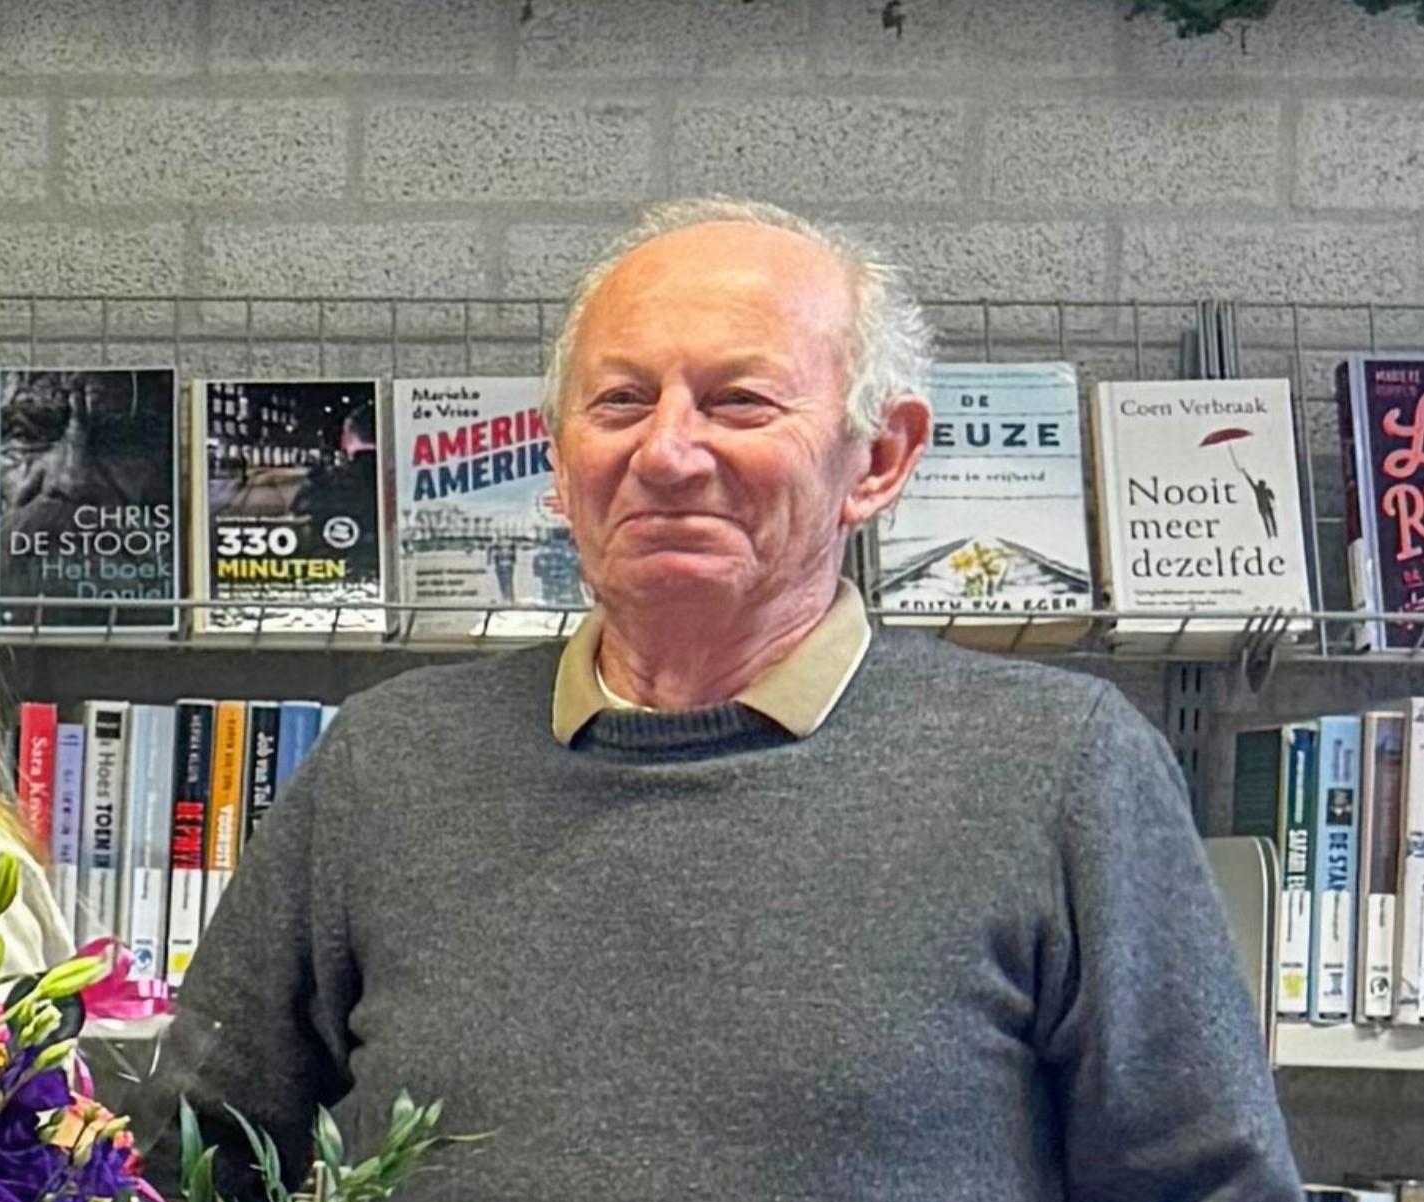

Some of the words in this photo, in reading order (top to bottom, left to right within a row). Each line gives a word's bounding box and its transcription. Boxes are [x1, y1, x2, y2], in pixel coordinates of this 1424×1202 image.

[411, 386, 481, 402] Marieke
[960, 394, 991, 408] DE
[1119, 400, 1173, 416] Coen
[1178, 398, 1268, 416] Verbraak
[412, 405, 433, 419] de
[436, 404, 480, 418] Vries
[412, 407, 550, 468] AMERIK
[931, 422, 1062, 447] EUZE
[413, 440, 554, 503] AMERIK
[1128, 478, 1238, 507] Nooit
[73, 503, 172, 529] CHRIS
[1129, 514, 1221, 541] meer
[9, 531, 50, 556] DE
[58, 531, 172, 556] STOOP
[216, 526, 298, 556] 330
[41, 556, 92, 580] Het
[99, 554, 172, 579] boek
[216, 558, 347, 579] MINUTEN
[1131, 546, 1286, 578] dezelfde
[30, 736, 48, 777] Sara
[97, 752, 115, 798] Hoes
[94, 803, 113, 850] TOEN
